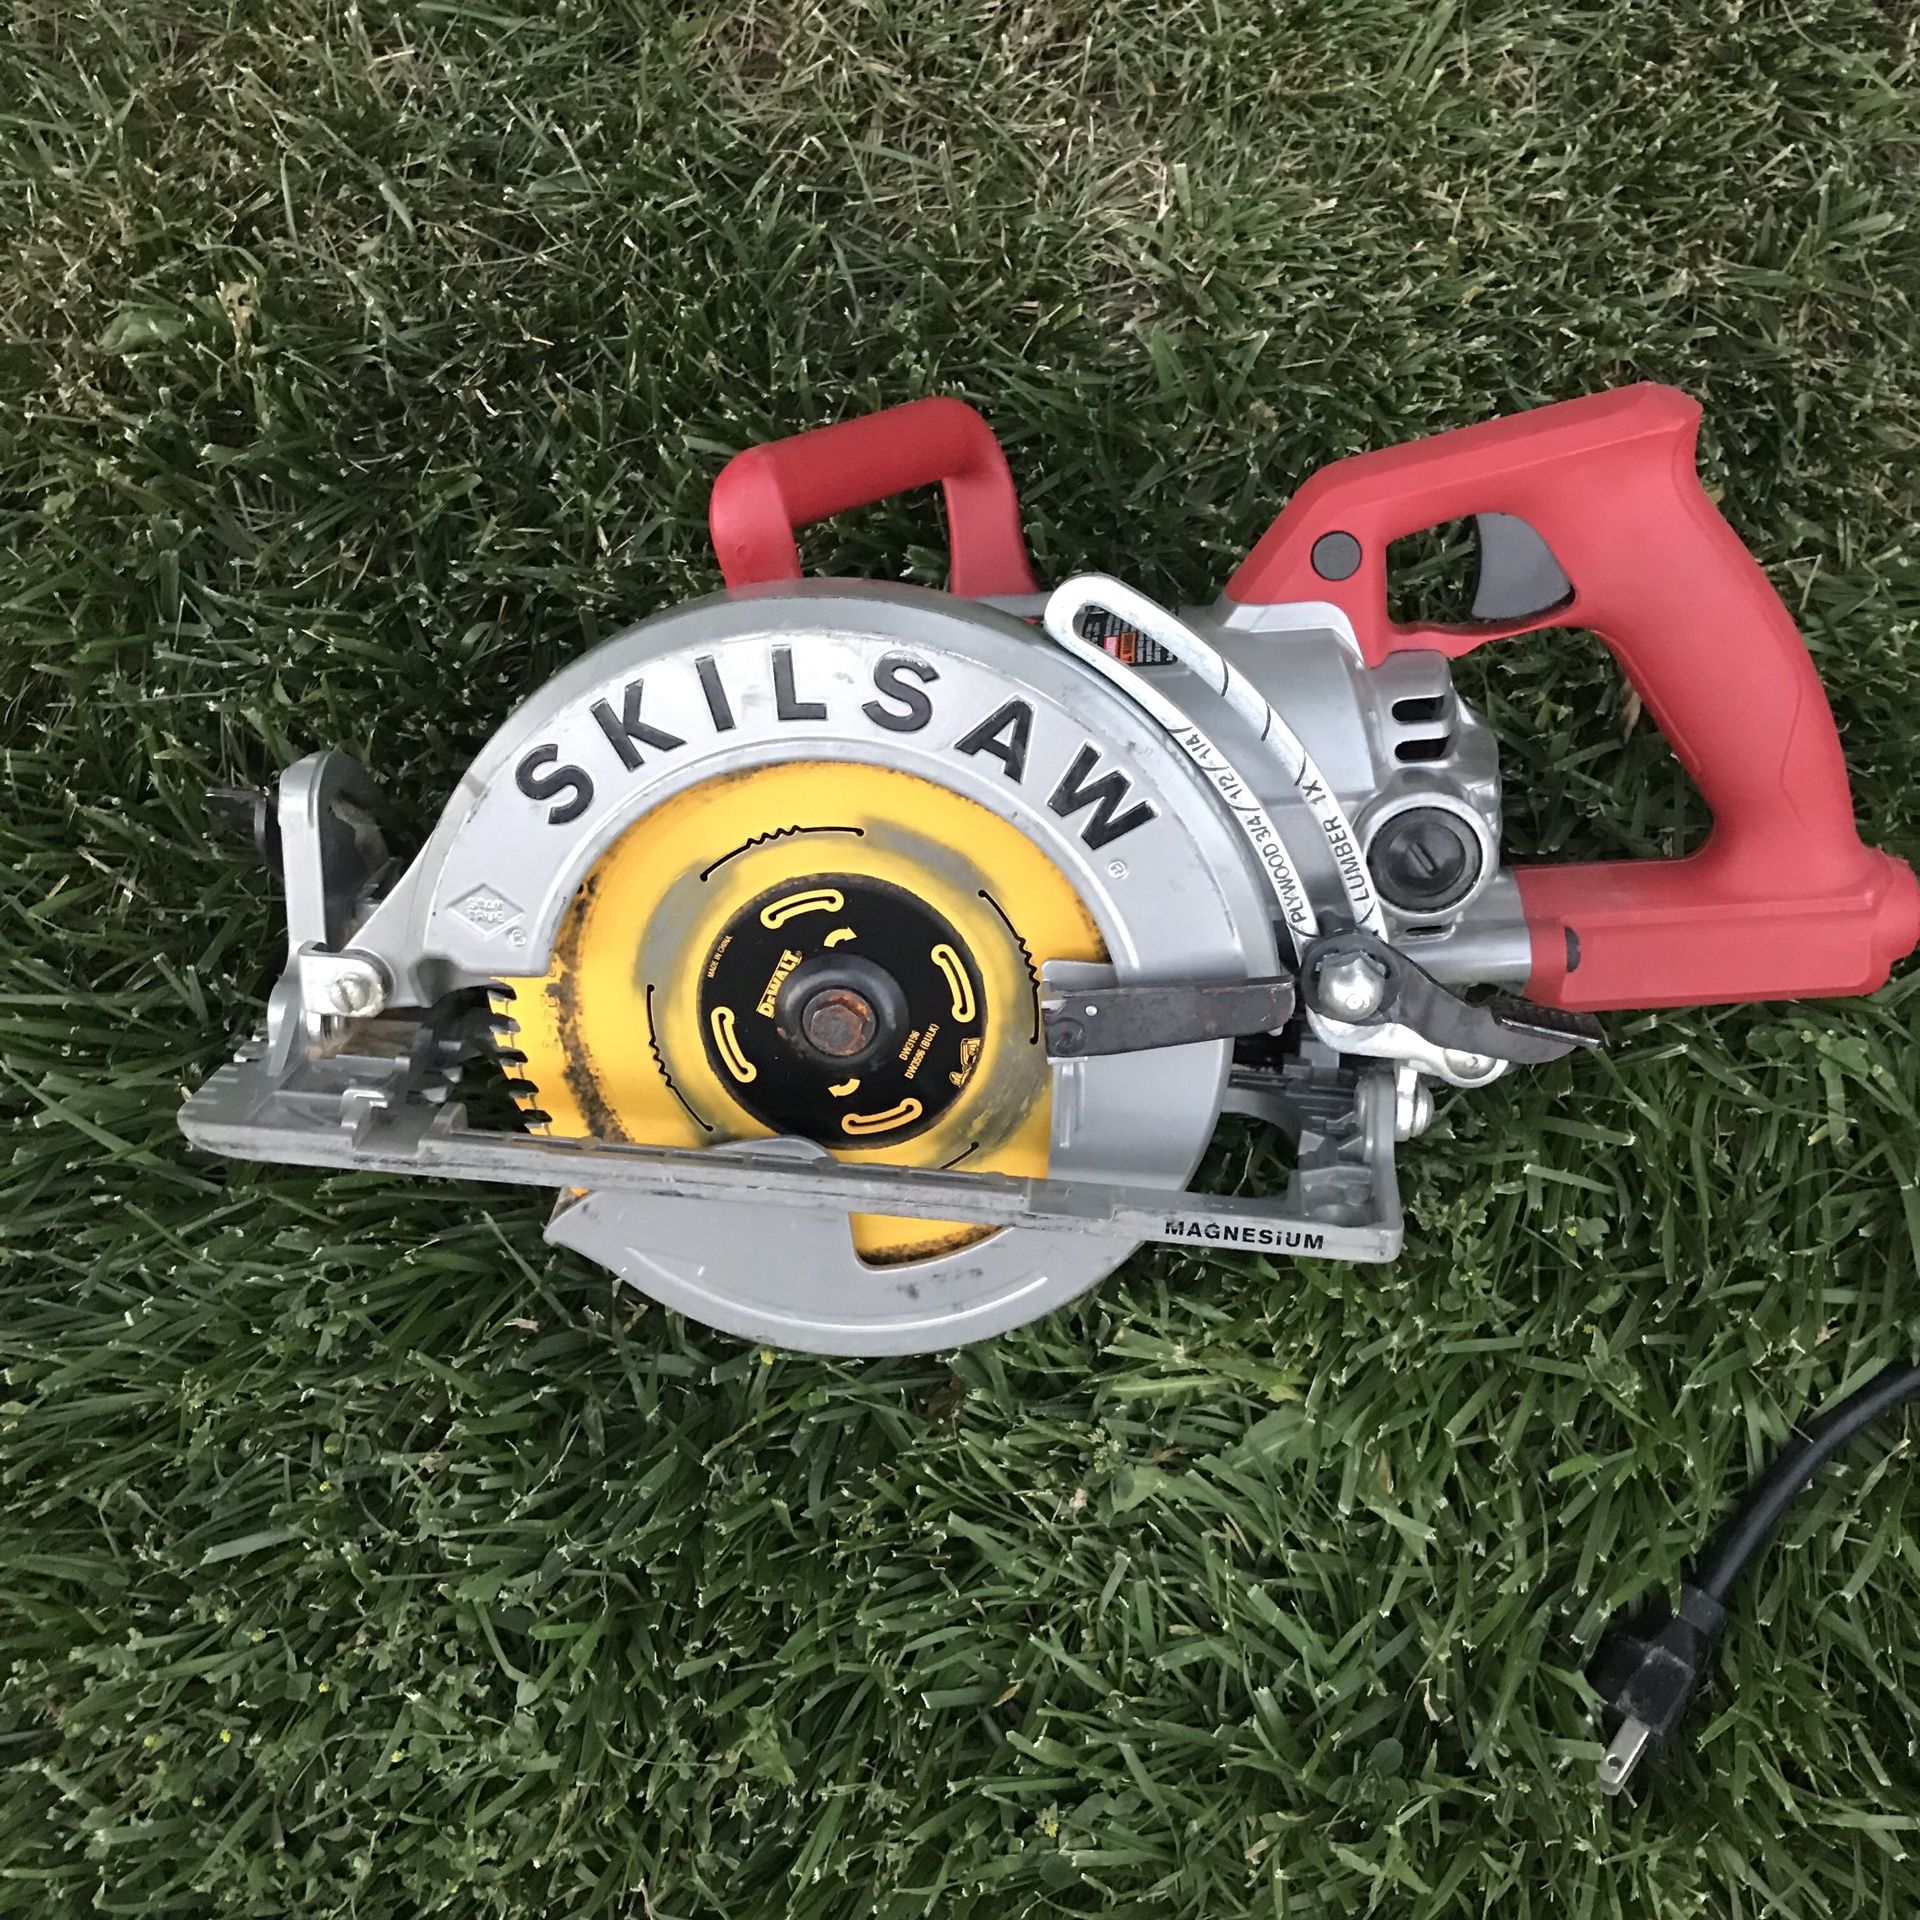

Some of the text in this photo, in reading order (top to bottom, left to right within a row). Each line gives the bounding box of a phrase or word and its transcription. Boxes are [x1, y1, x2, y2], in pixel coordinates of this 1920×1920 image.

[516, 643, 1159, 851] SKILSAW
[1185, 733, 1307, 923] PLYWOOD 3/4 1/2 1/4
[1302, 780, 1370, 901] LUMBER 1X
[707, 960, 718, 979] MADE
[718, 935, 733, 953] CHINA
[756, 949, 802, 1019] DEWALT
[898, 1029, 920, 1060] DW3196
[919, 1023, 940, 1049] (BULK)
